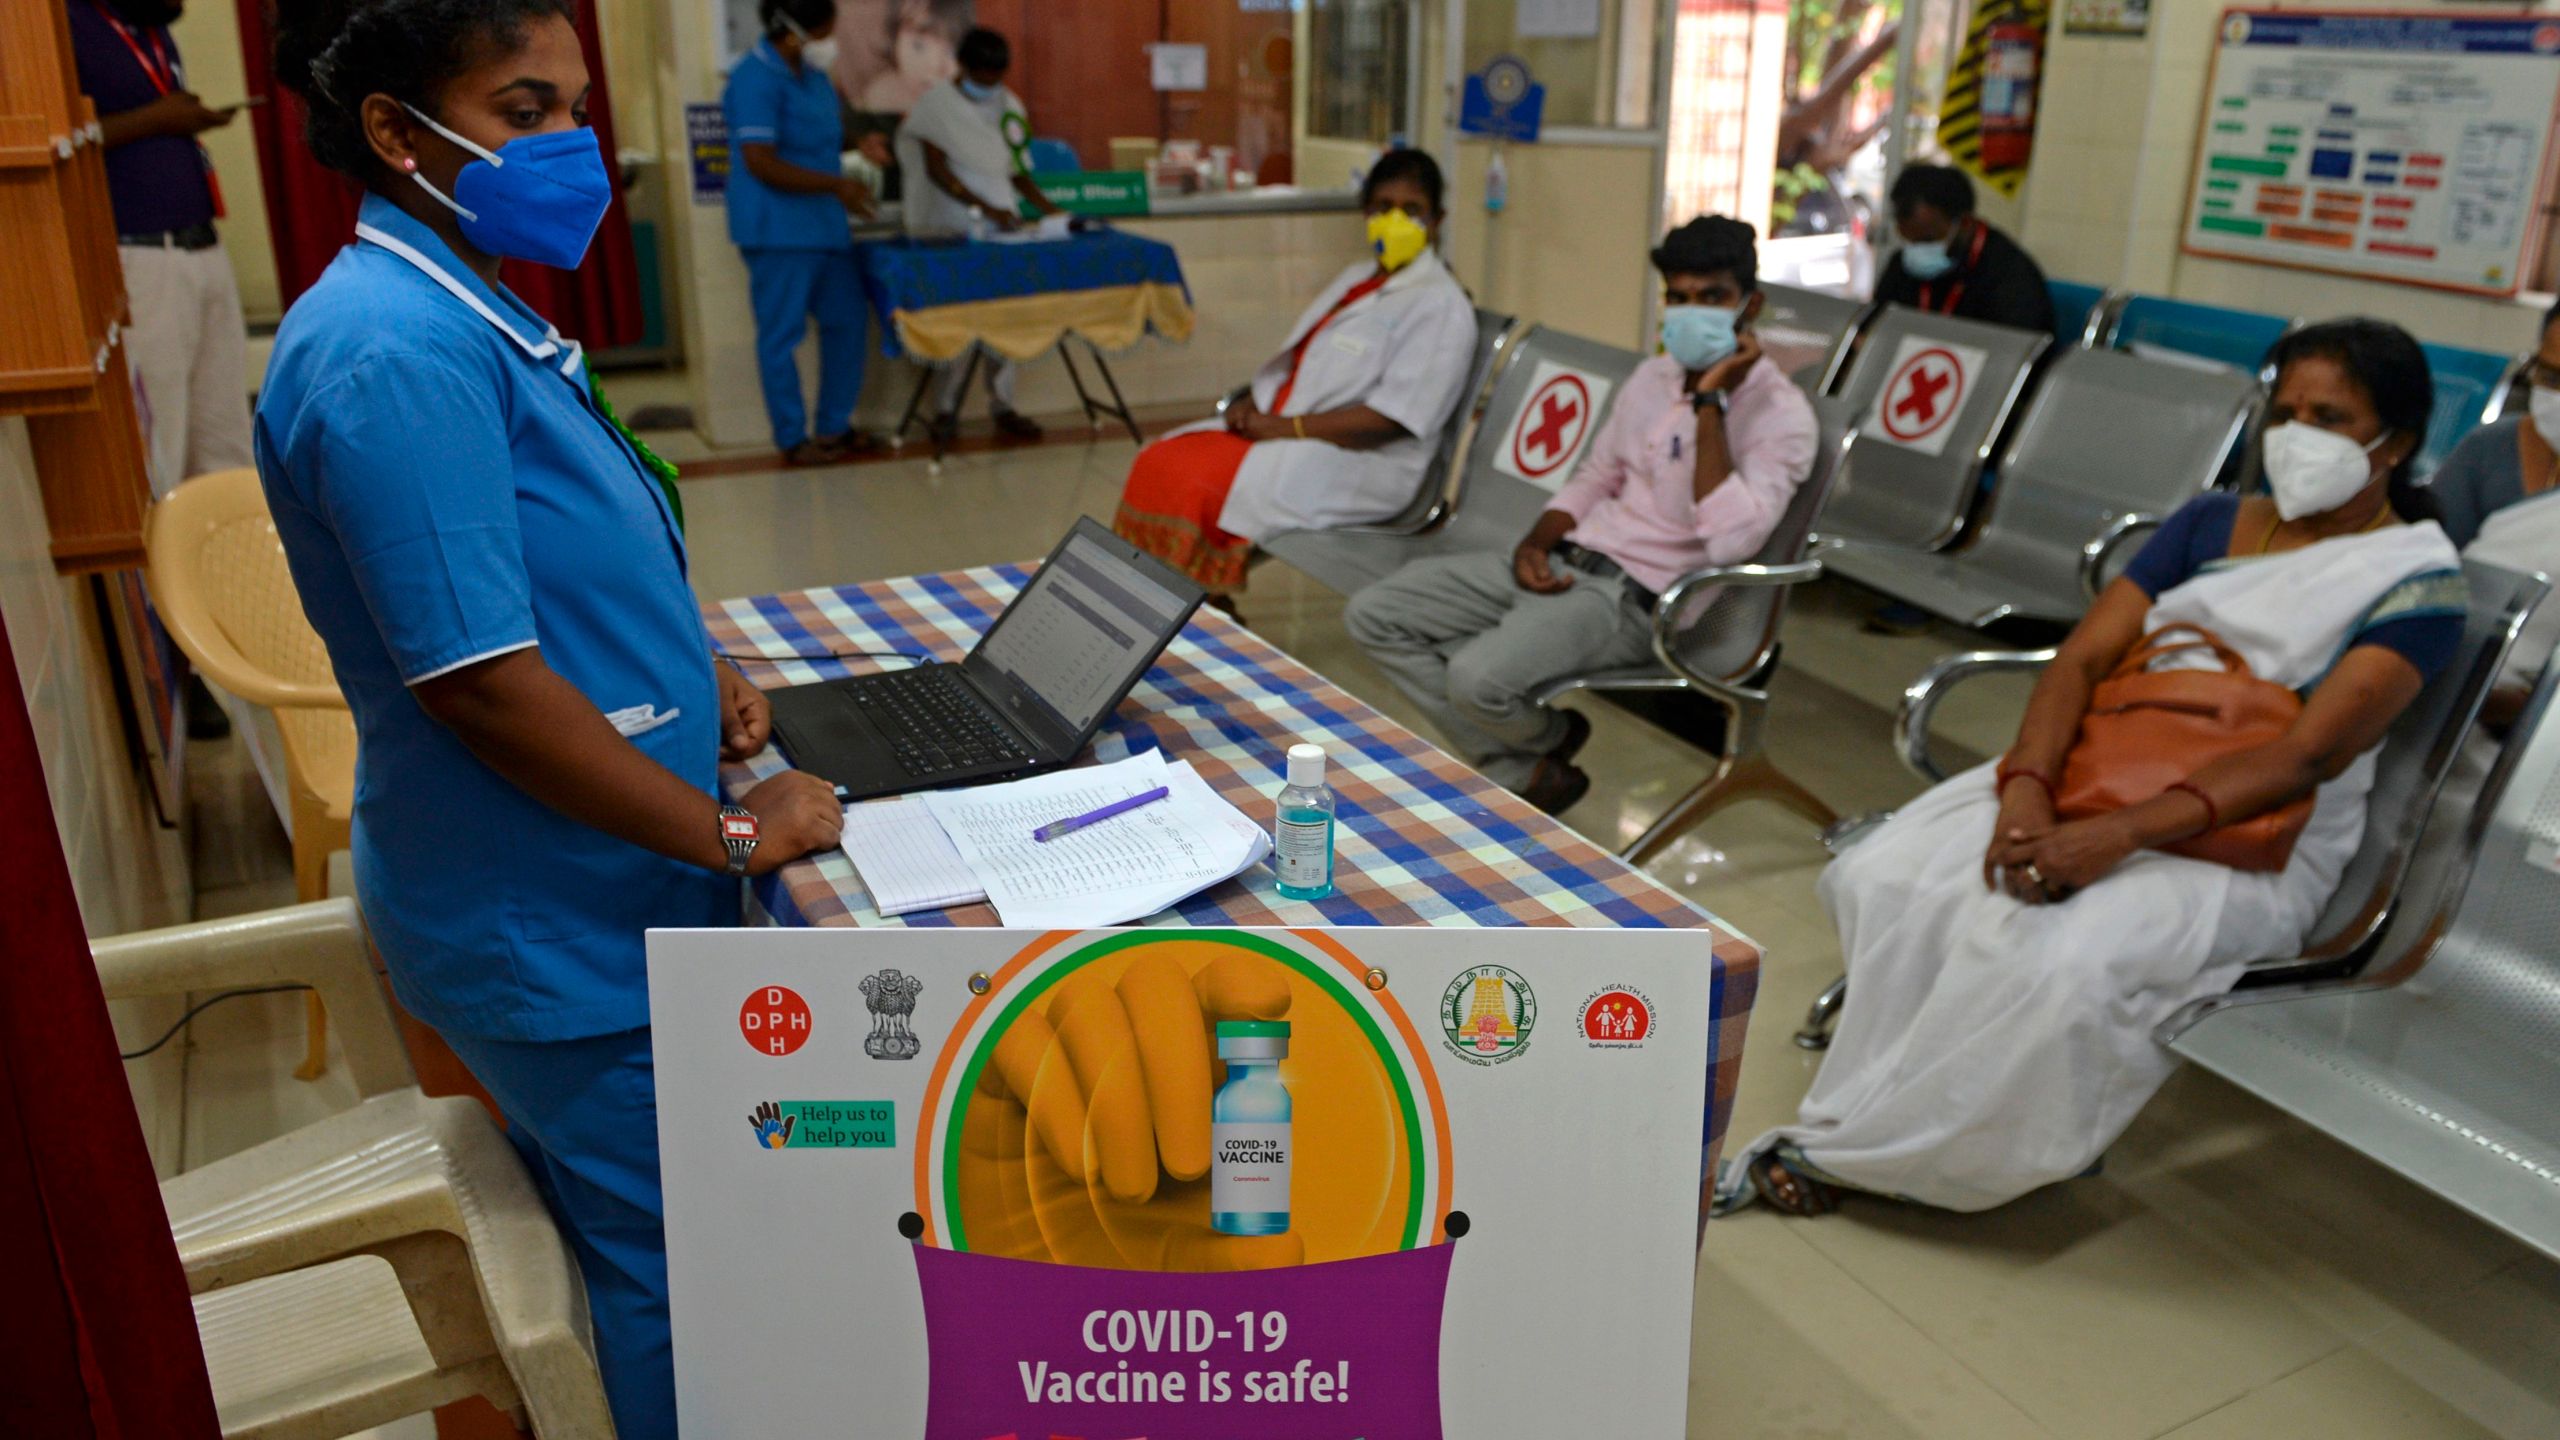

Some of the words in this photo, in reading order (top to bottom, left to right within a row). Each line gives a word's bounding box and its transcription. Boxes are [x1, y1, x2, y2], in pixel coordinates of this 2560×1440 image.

[1576, 992, 1600, 1038] NATIONAL
[1602, 984, 1640, 996] HEALTH
[1641, 995, 1657, 1039] MISSION
[802, 1106, 842, 1124] Help
[847, 1110, 865, 1121] us
[870, 1108, 887, 1121] to
[805, 1127, 846, 1146] help
[851, 1131, 886, 1146] you
[1226, 1140, 1277, 1150] COVID-19
[1219, 1151, 1284, 1163] VACCINE
[1082, 1309, 1288, 1353] COVID-19
[1018, 1360, 1186, 1403] Vaccine
[1199, 1360, 1232, 1403] is
[1243, 1359, 1349, 1403] safe!
